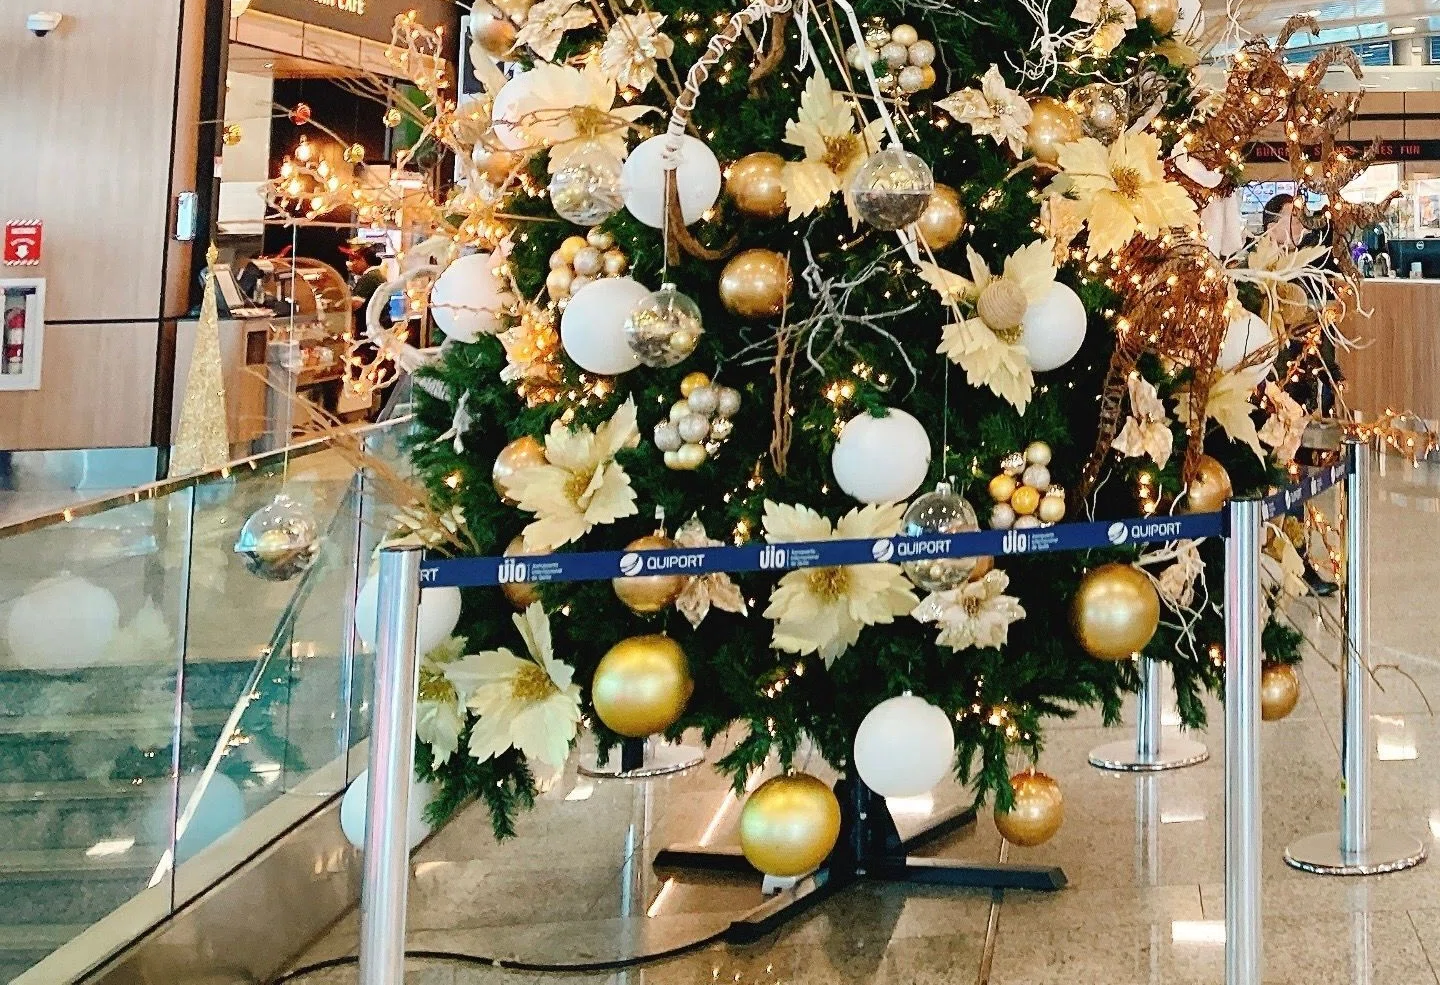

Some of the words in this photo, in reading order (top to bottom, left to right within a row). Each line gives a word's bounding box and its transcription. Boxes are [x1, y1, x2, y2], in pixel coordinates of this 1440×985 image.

[1131, 522, 1182, 538] QUIPORT
[897, 539, 952, 557] QUIPORT
[646, 553, 706, 570] QUIPORT
